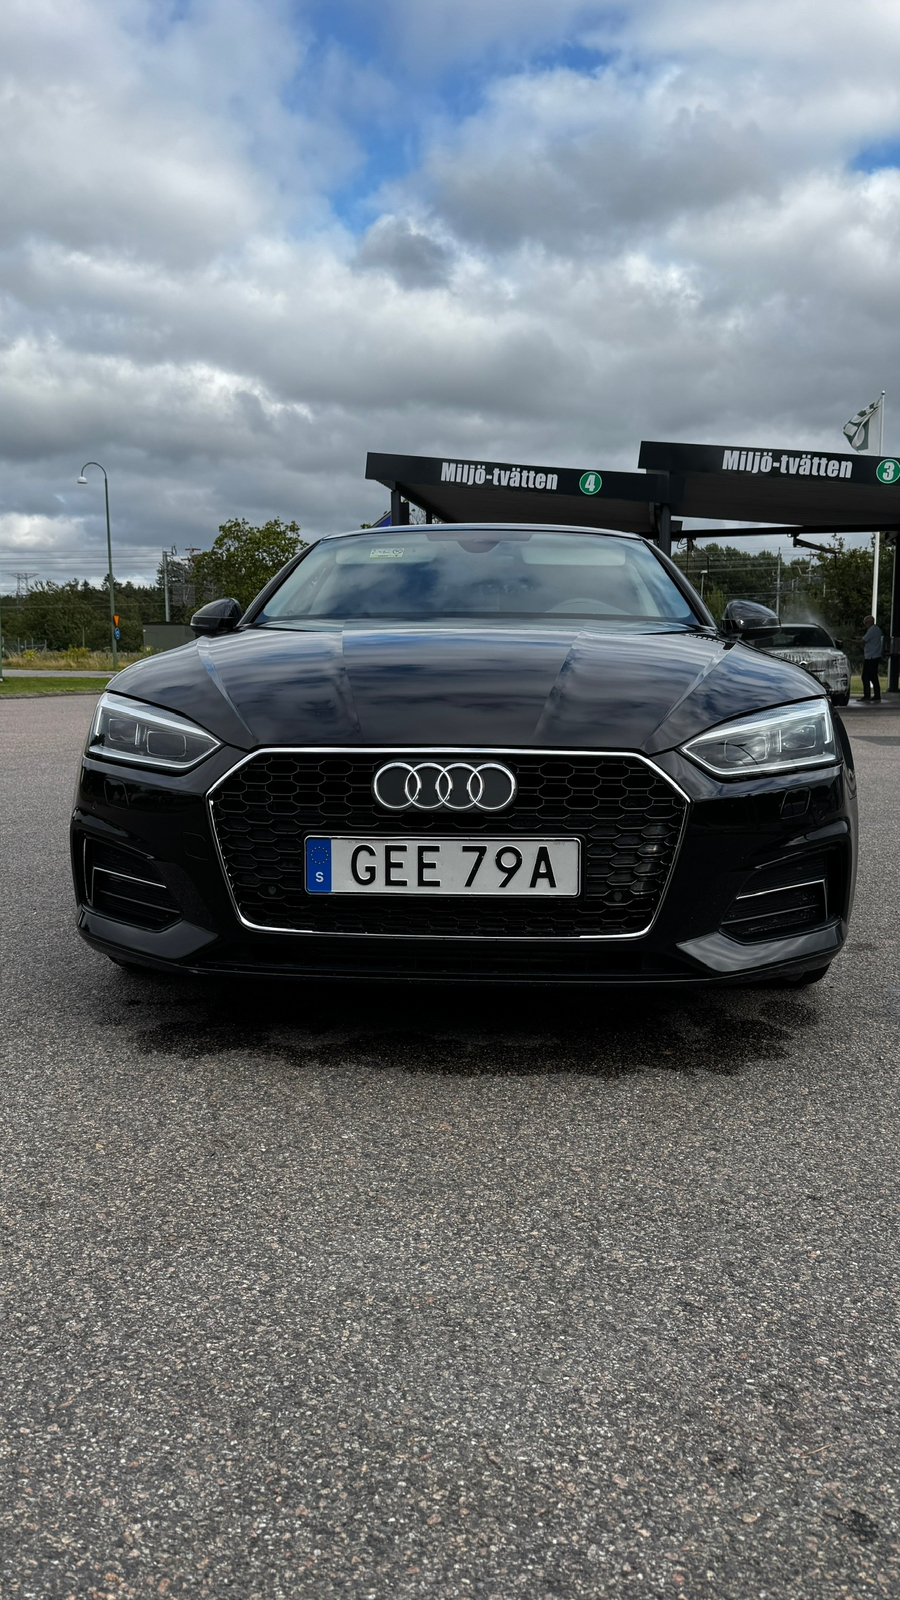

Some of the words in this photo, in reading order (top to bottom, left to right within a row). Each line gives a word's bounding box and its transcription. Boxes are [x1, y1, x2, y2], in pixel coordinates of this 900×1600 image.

[441, 462, 558, 490] Miljö-tvätten
[584, 474, 596, 491] 4
[722, 450, 853, 479] Miljö-tvätten
[882, 461, 895, 481] 3
[315, 871, 324, 883] S
[350, 845, 441, 887] GEE
[461, 845, 557, 888] 79A
